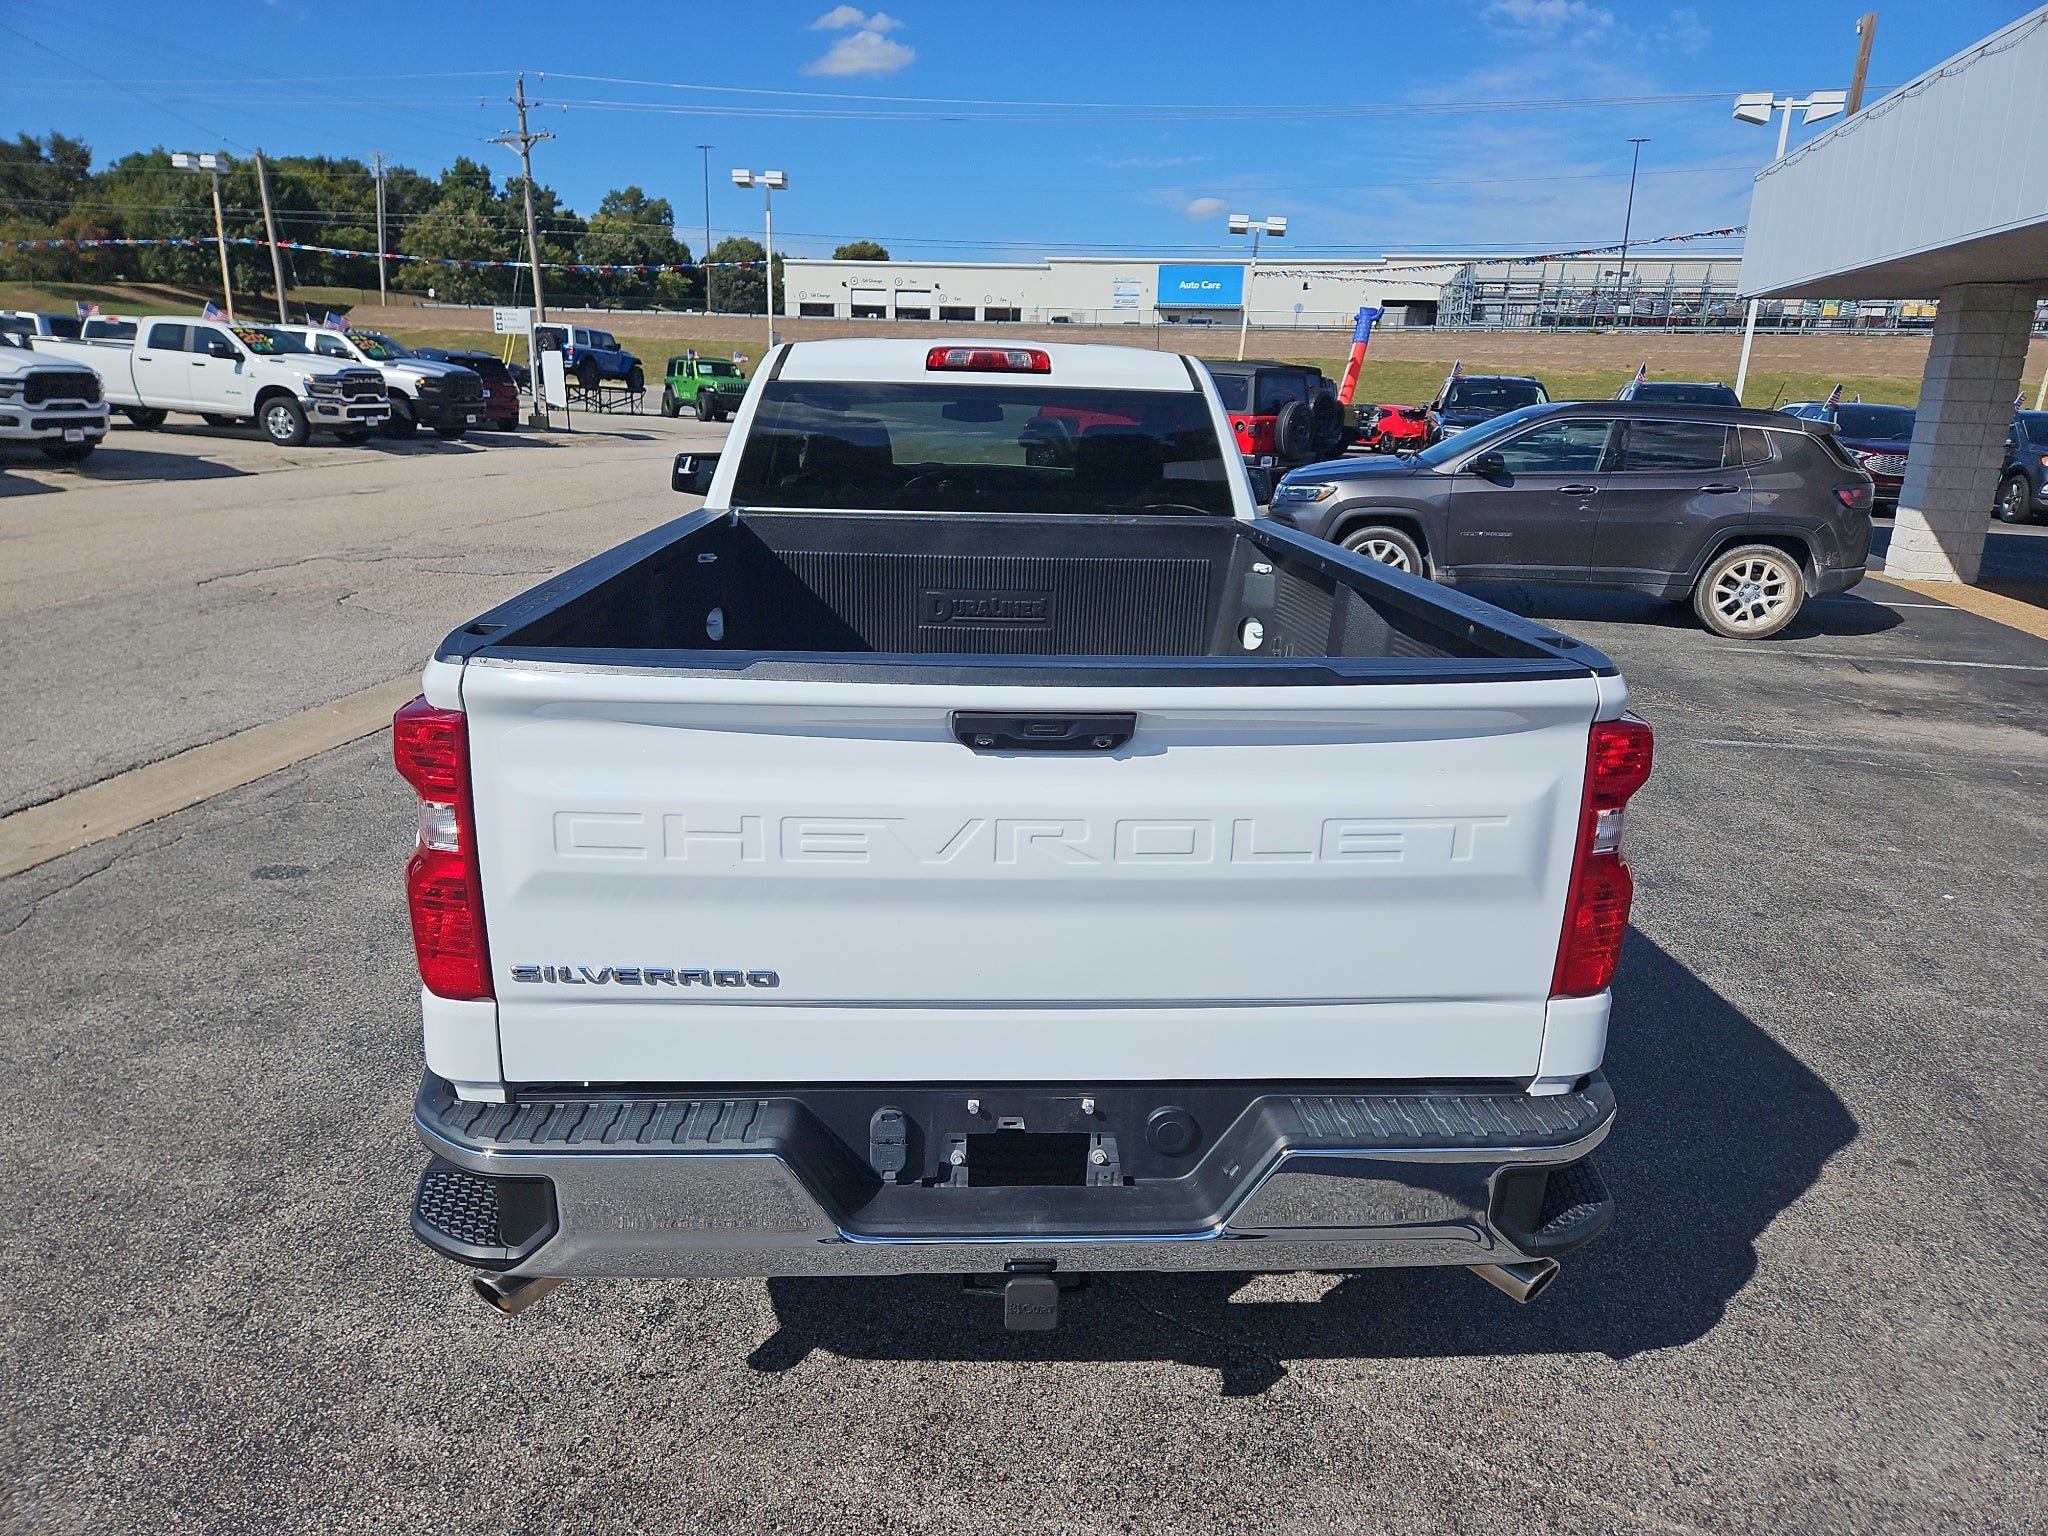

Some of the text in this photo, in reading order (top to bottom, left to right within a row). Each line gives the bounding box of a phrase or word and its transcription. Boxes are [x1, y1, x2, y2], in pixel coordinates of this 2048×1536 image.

[1179, 280, 1222, 290] Auto Care
[553, 811, 1510, 864] CHEVROLET
[510, 965, 780, 988] SILVERADO
